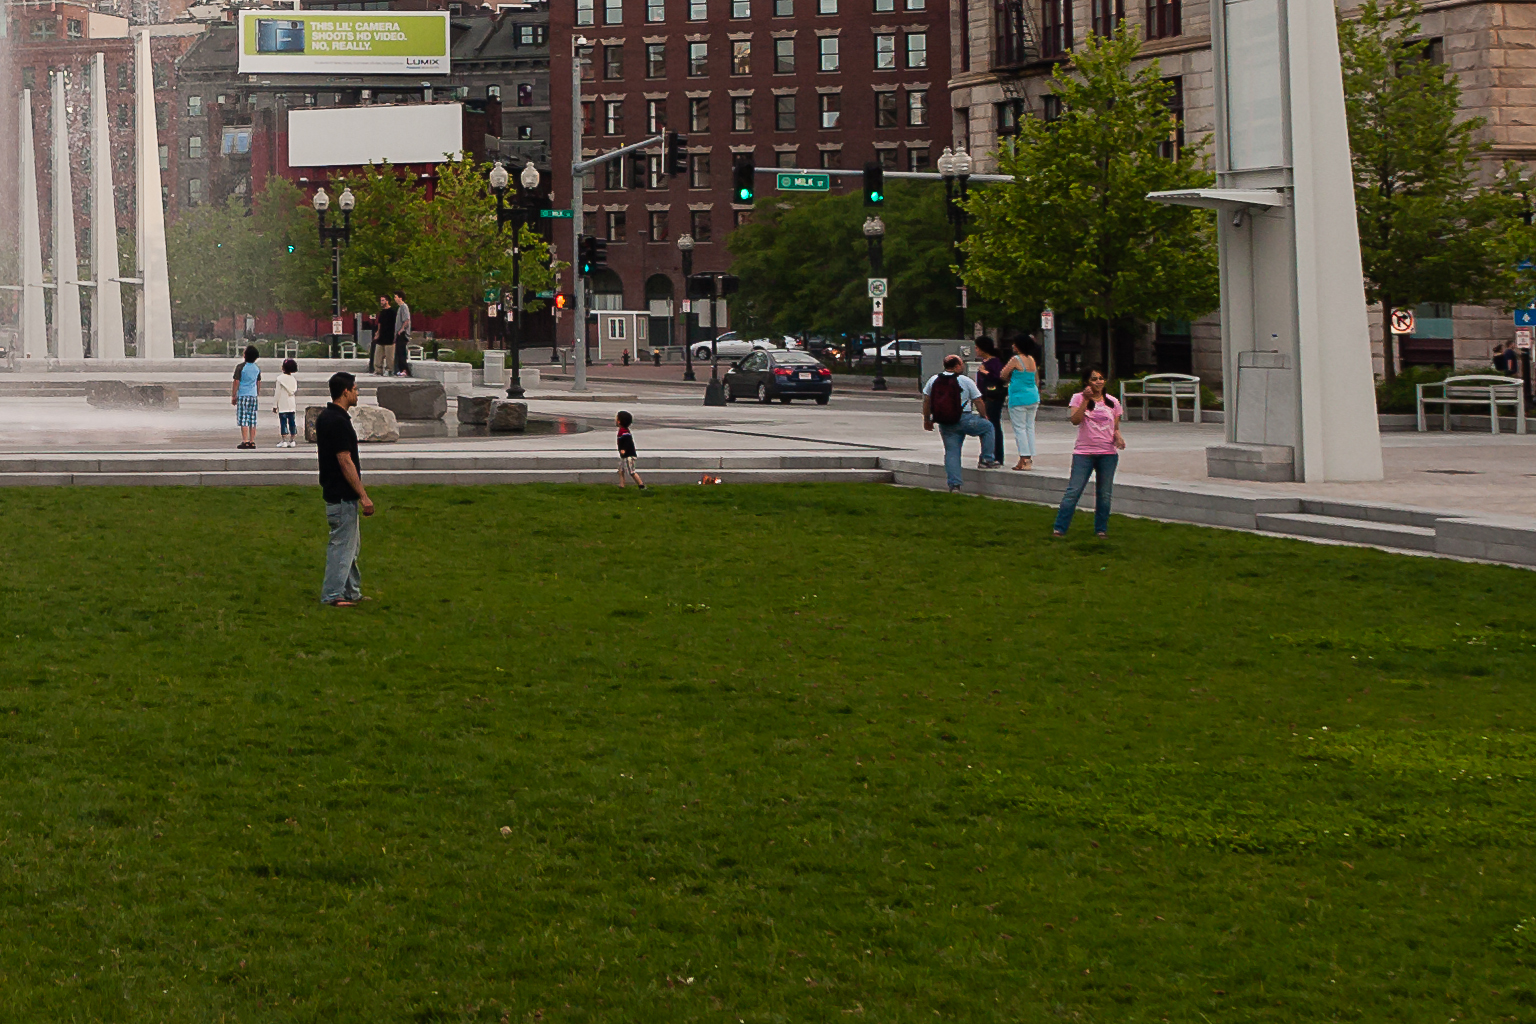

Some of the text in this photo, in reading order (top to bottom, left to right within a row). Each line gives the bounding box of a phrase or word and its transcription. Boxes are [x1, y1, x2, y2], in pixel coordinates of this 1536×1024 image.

[310, 21, 401, 31] THIS LIL' CAMERA
[311, 31, 408, 41] SHOOTS HD VIDEO.
[311, 41, 372, 52] NO, REALLY.
[406, 57, 440, 66] LUMIX
